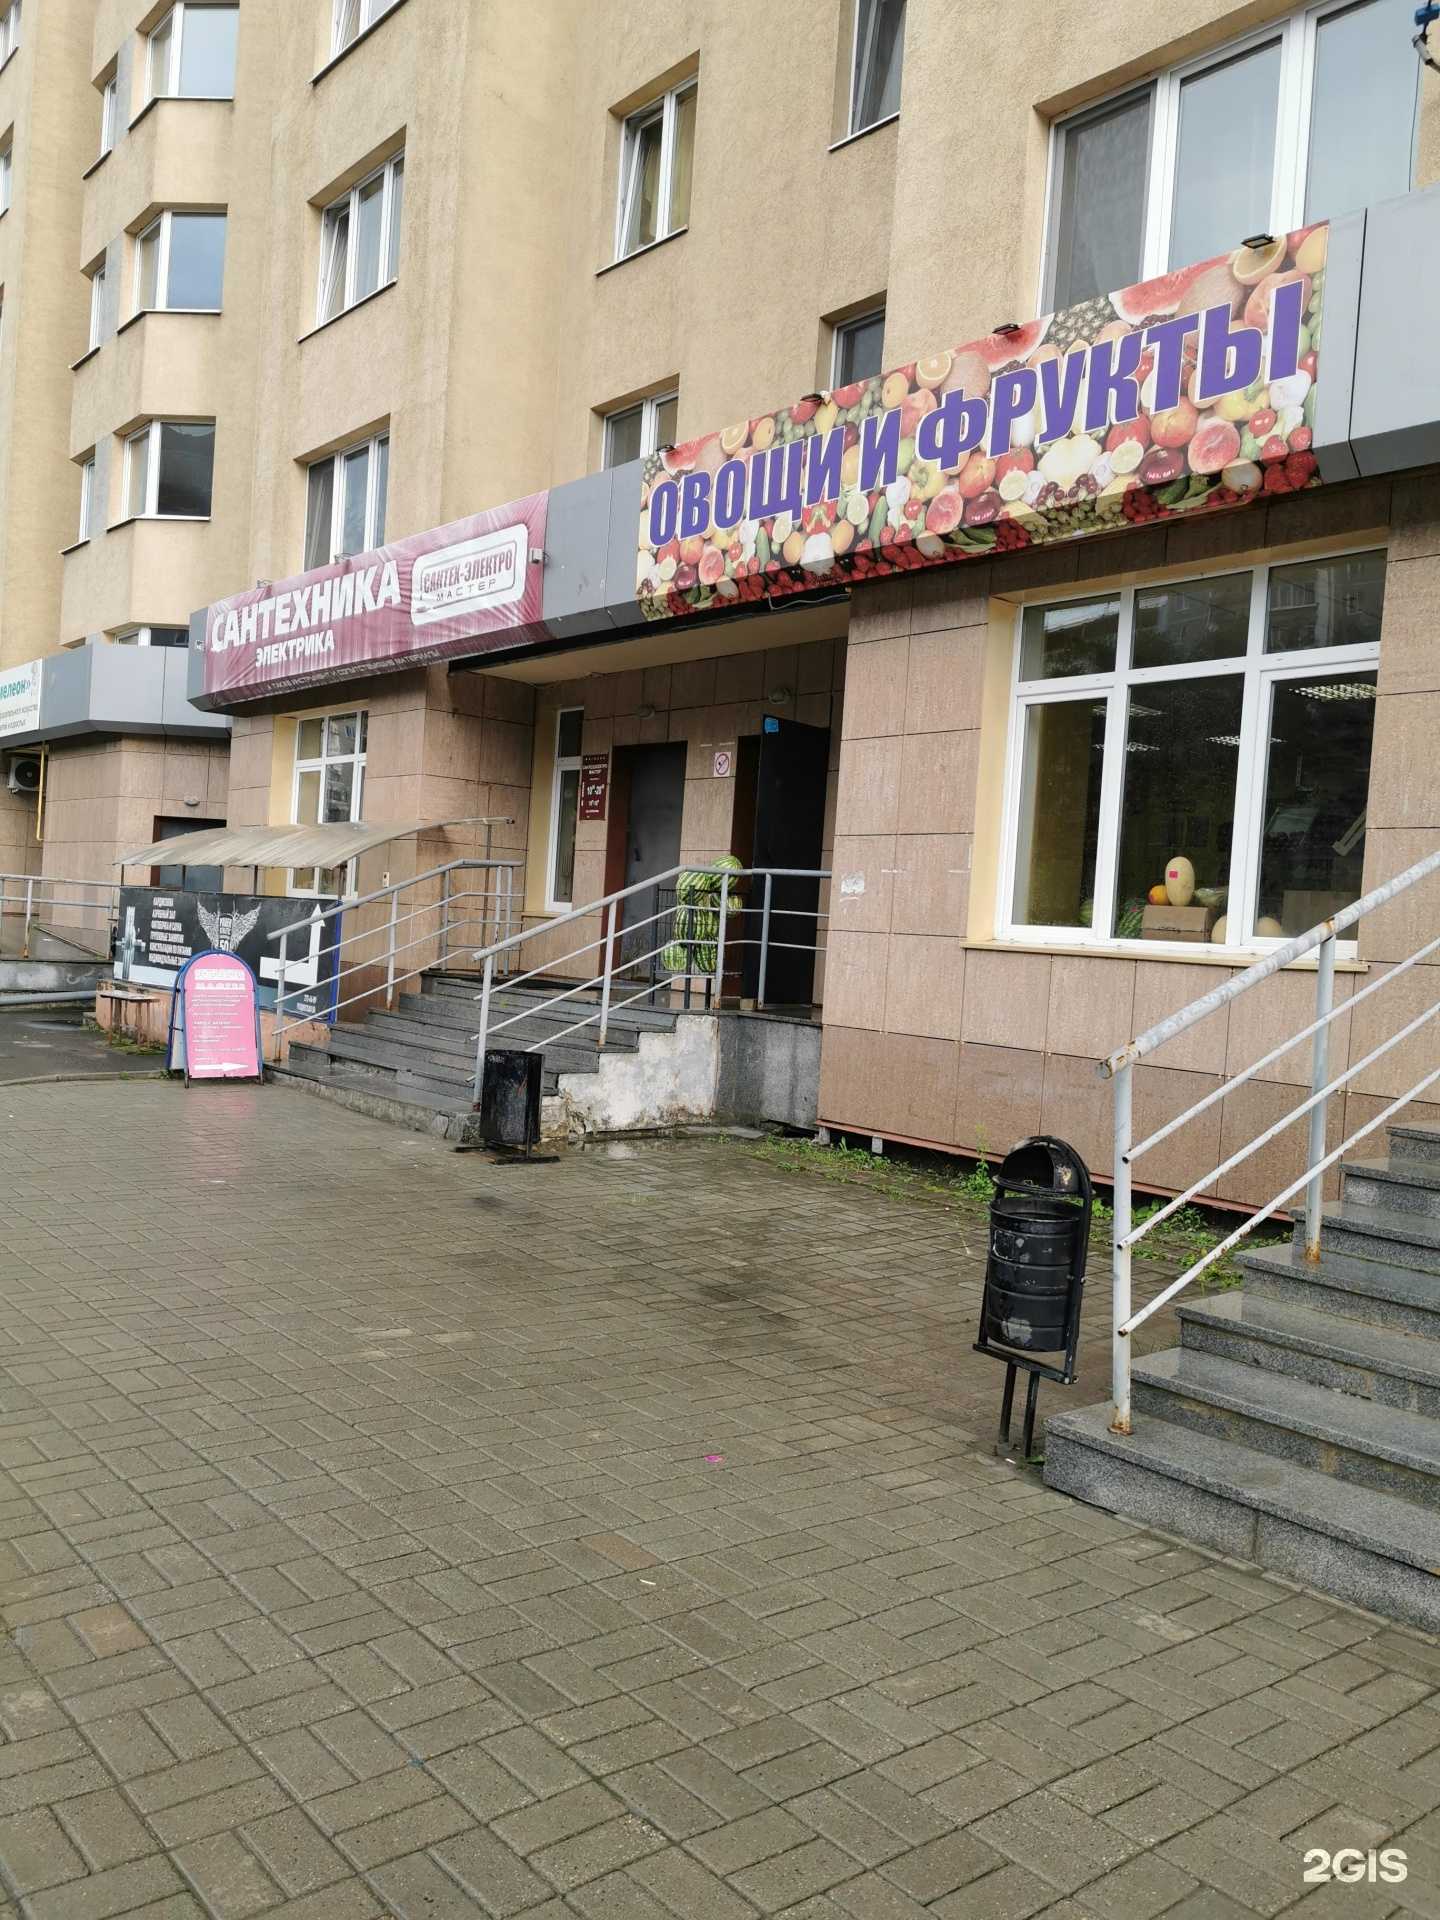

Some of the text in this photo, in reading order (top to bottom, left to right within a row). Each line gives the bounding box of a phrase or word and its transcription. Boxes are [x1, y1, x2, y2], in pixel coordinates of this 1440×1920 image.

[648, 278, 1304, 548] ОВОЩИ И ФРУКТЫ
[424, 549, 513, 593] САНТЕХ-ЭЛЕКТРО
[436, 578, 497, 601] МАСТЕР
[211, 560, 401, 652] САНТЕХНИКА
[256, 629, 335, 667] ЭЛЕКТРИКА
[0, 679, 31, 700] елеон»
